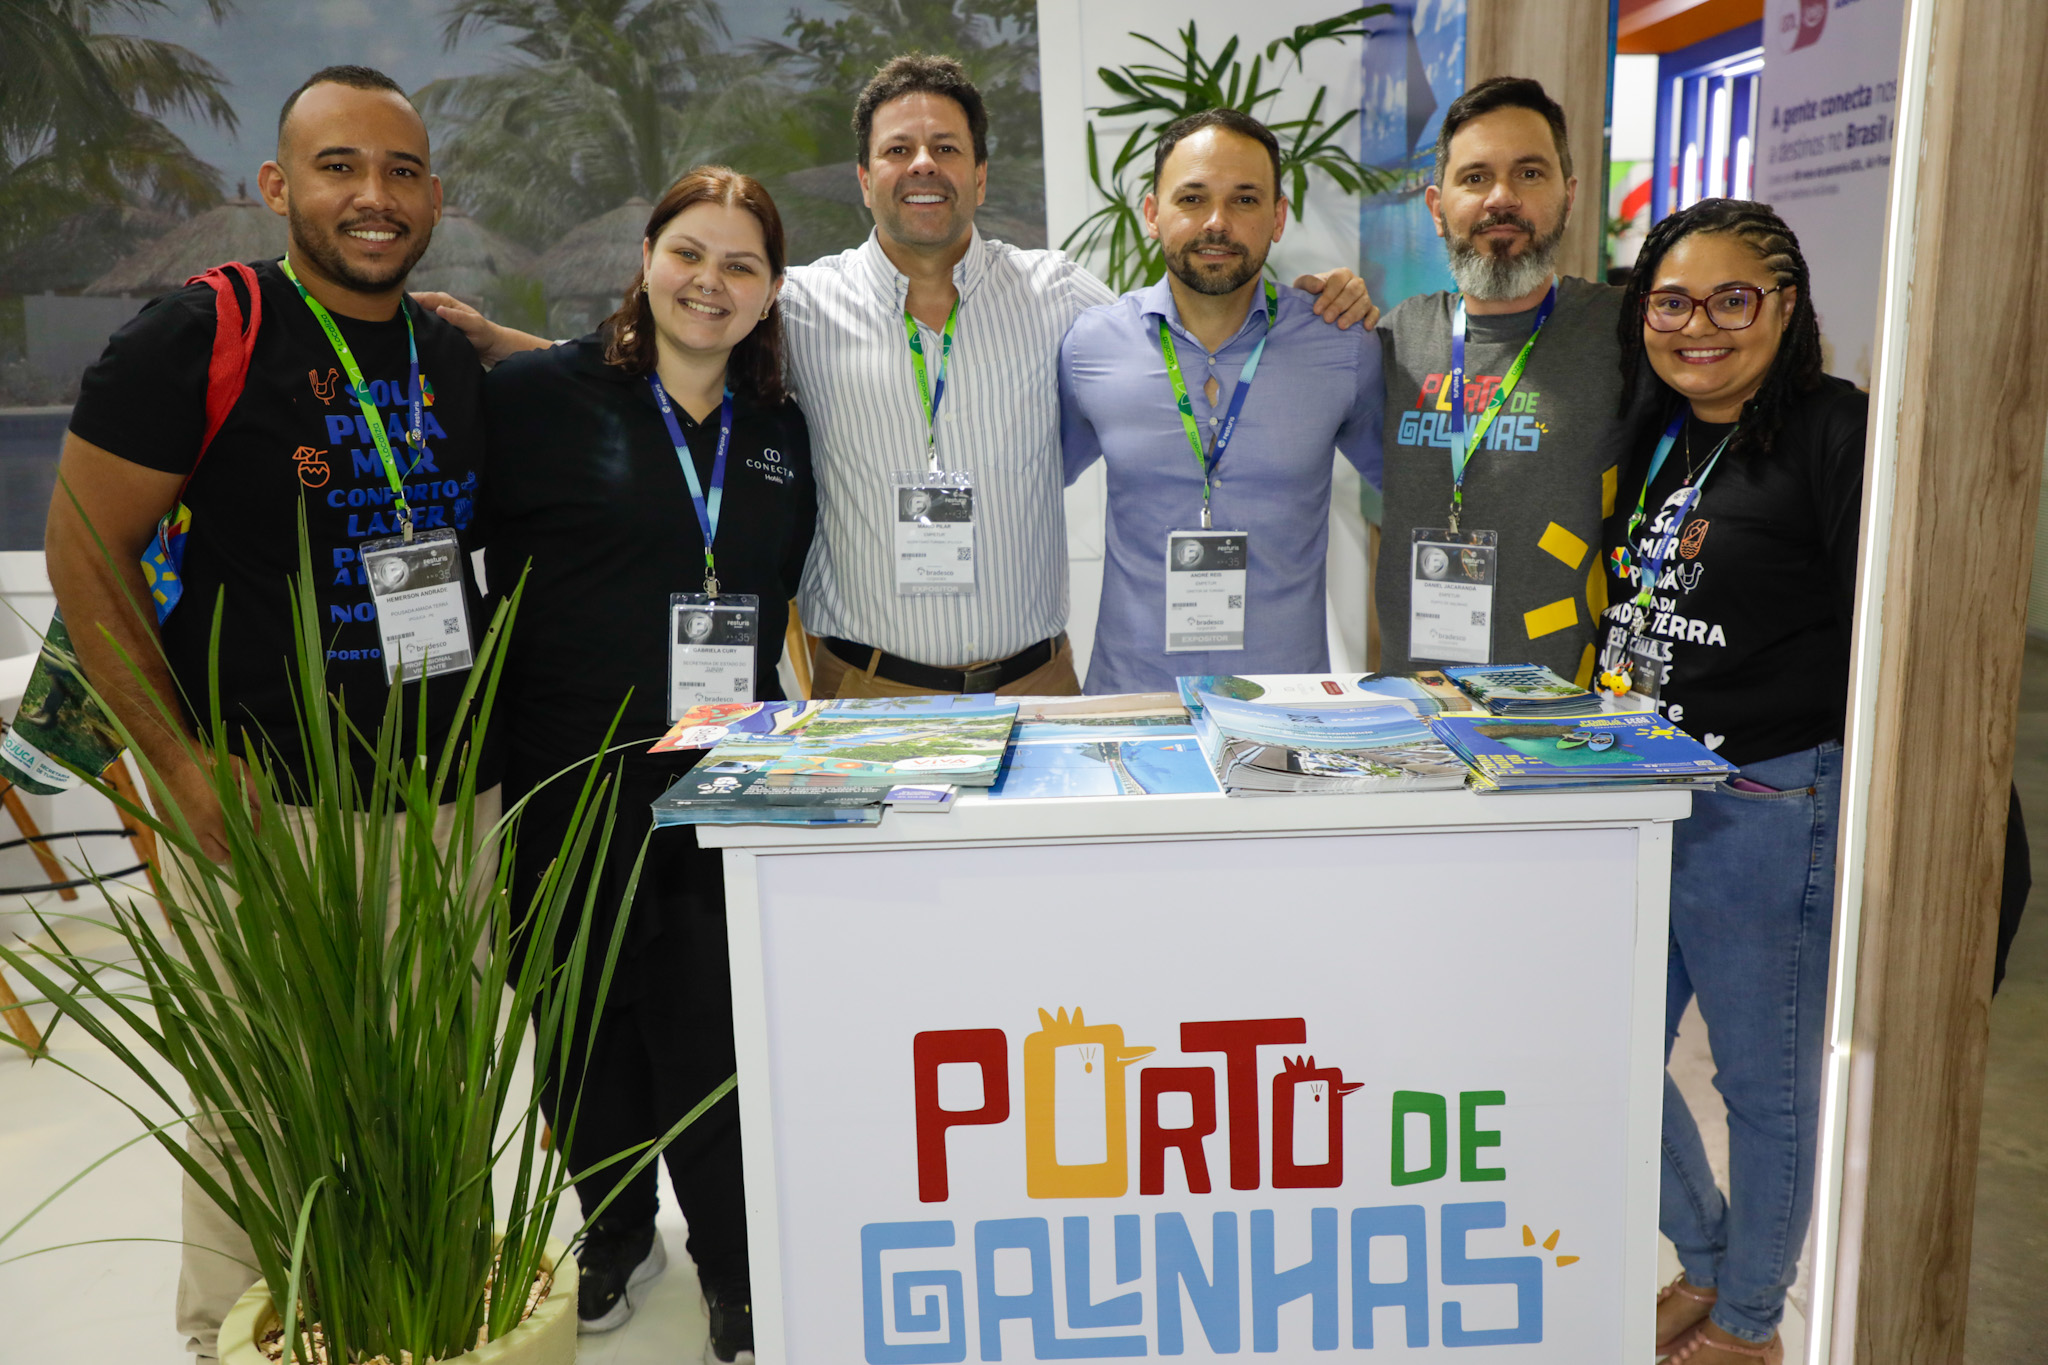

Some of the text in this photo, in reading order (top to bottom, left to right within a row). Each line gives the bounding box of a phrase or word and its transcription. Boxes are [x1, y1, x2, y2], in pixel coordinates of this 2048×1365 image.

[1820, 84, 1872, 117] conecta
[1847, 113, 1886, 149] Brasil
[1510, 391, 1541, 414] DE
[745, 458, 795, 479] CONECTA
[386, 587, 448, 604] HEMERSON ANDRADE
[1651, 611, 1727, 647] TERRA
[704, 695, 734, 703] bradesco
[913, 1006, 1506, 1203] PORTO DE
[860, 1200, 1543, 1365] GALINHAS
